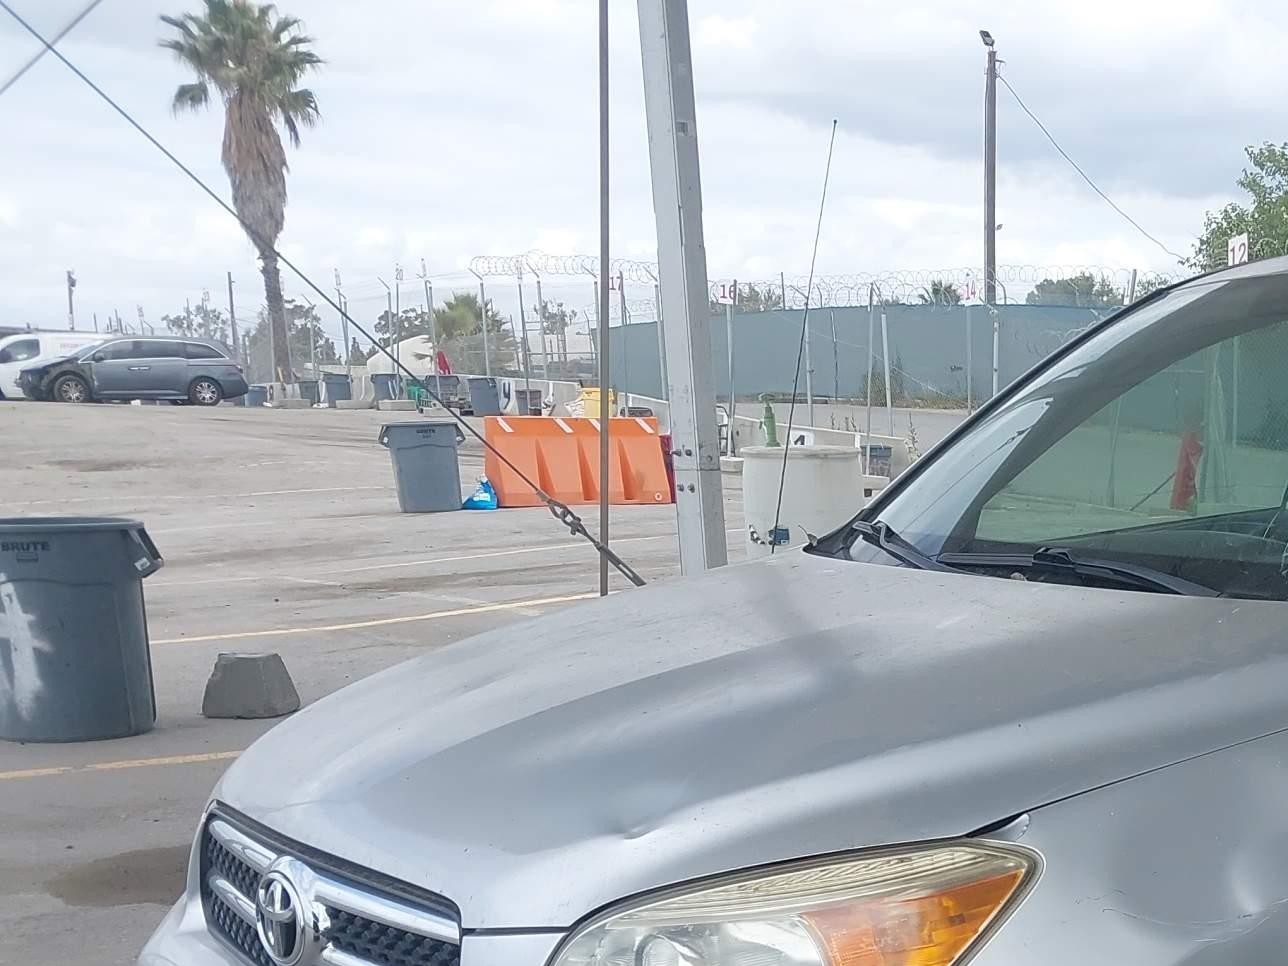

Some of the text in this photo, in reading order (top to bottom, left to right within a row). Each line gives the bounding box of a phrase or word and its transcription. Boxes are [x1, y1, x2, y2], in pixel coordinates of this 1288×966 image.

[1230, 242, 1247, 265] 12
[965, 279, 977, 301] 14
[1, 541, 51, 552] BRUTE
